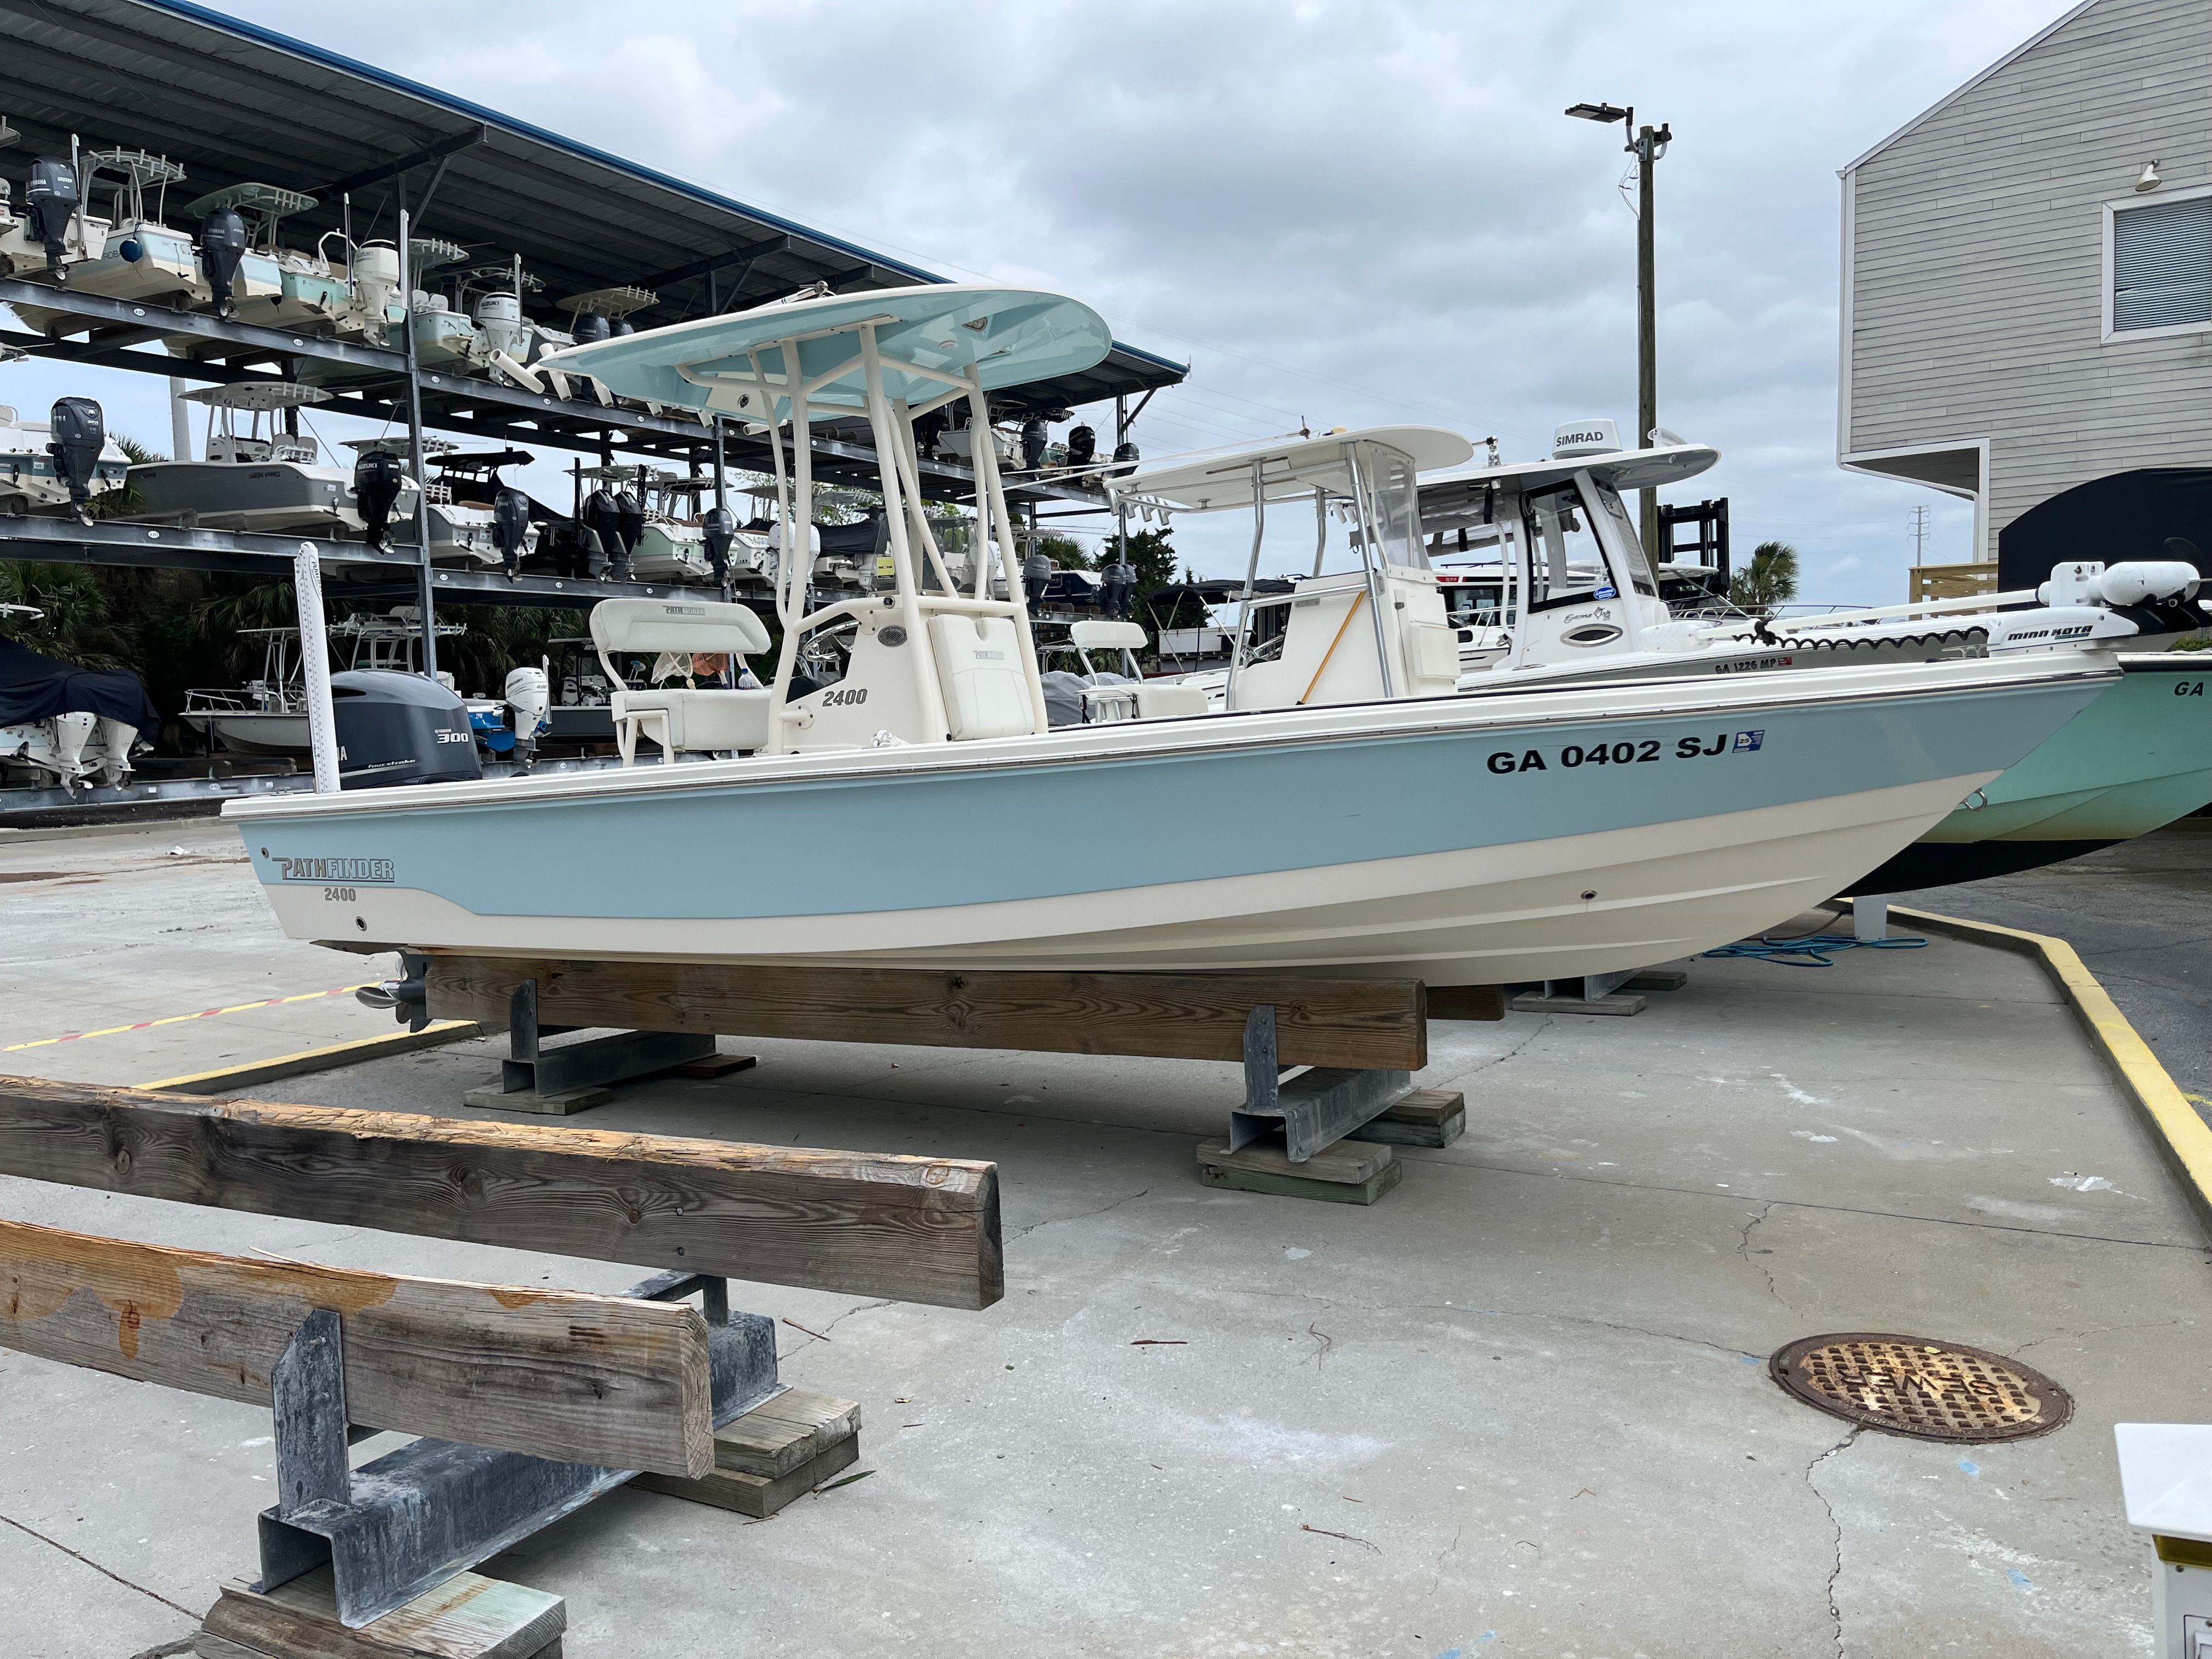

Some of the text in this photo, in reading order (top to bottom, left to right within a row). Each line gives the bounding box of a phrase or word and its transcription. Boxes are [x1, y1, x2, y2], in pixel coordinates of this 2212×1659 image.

[1556, 431, 1604, 447] SIMRAD
[1715, 664, 1730, 674] GA
[1734, 661, 1758, 672] 1226
[1760, 658, 1776, 669] MP
[2174, 681, 2204, 696] GA
[822, 689, 868, 707] 2400
[437, 733, 469, 744] 300
[1487, 734, 1728, 774] GA 0402 SJ
[272, 857, 394, 880] PATHFINDER
[324, 887, 357, 901] 2400
[1837, 1369, 1999, 1395] SEWER
